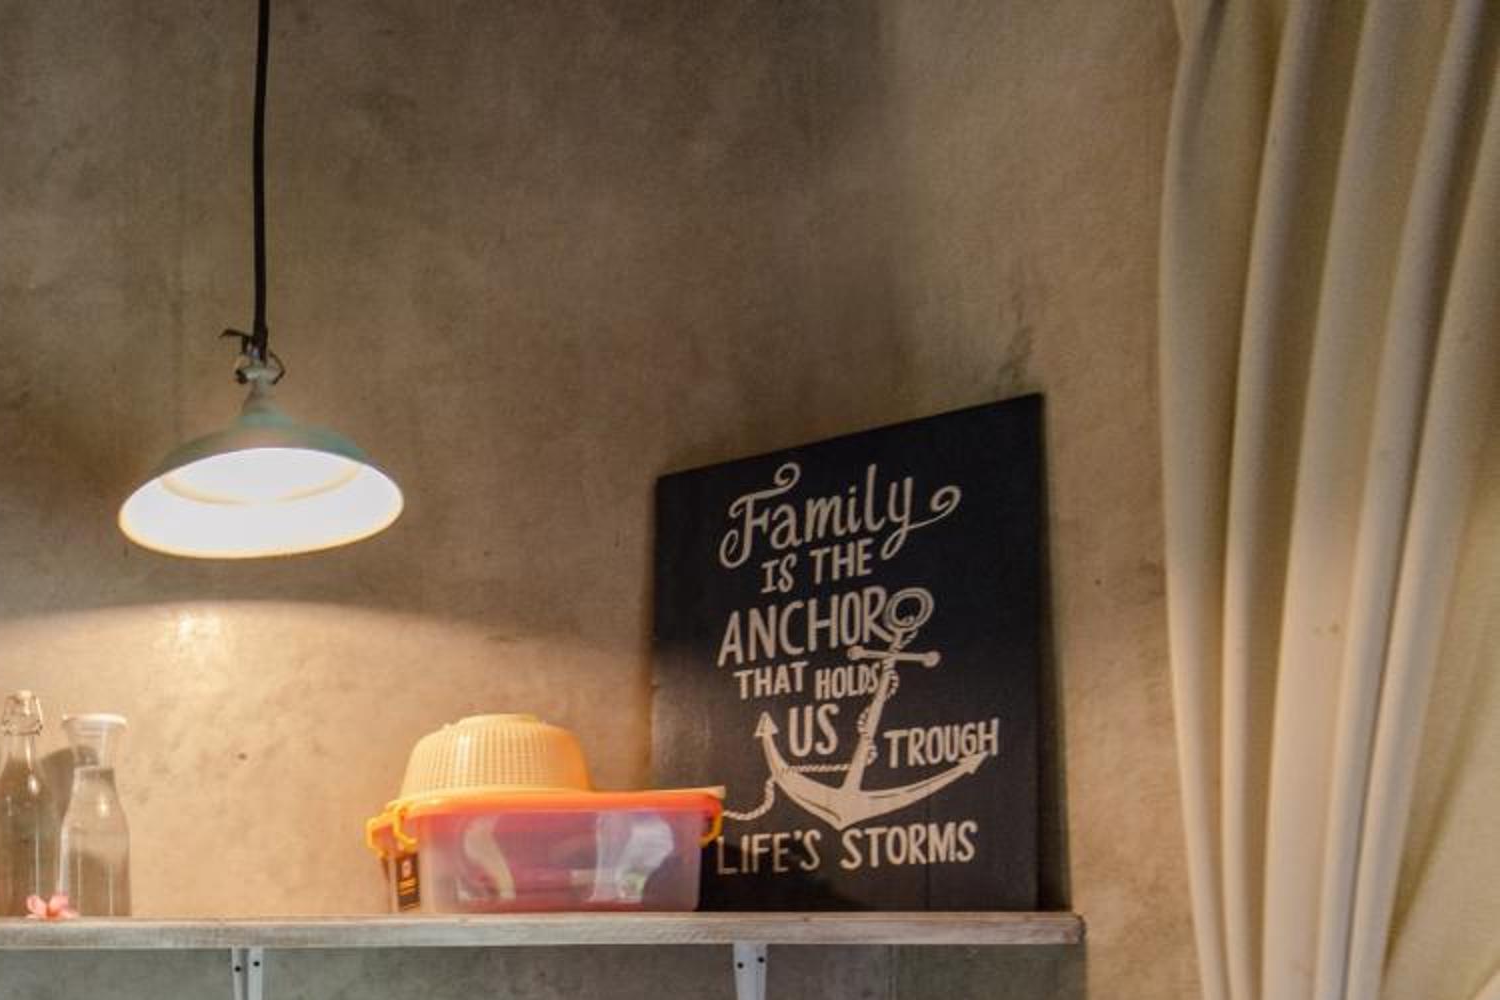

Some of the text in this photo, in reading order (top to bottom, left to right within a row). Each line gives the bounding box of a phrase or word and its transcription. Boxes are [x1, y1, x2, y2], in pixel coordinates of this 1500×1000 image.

[718, 462, 961, 569] Family
[760, 537, 875, 594] IS THE
[717, 585, 898, 667] ANCHOR
[734, 660, 883, 701] THAT HOLDS
[789, 703, 1000, 769] US TROUGH
[716, 820, 980, 876] LIFE'S STORMS
